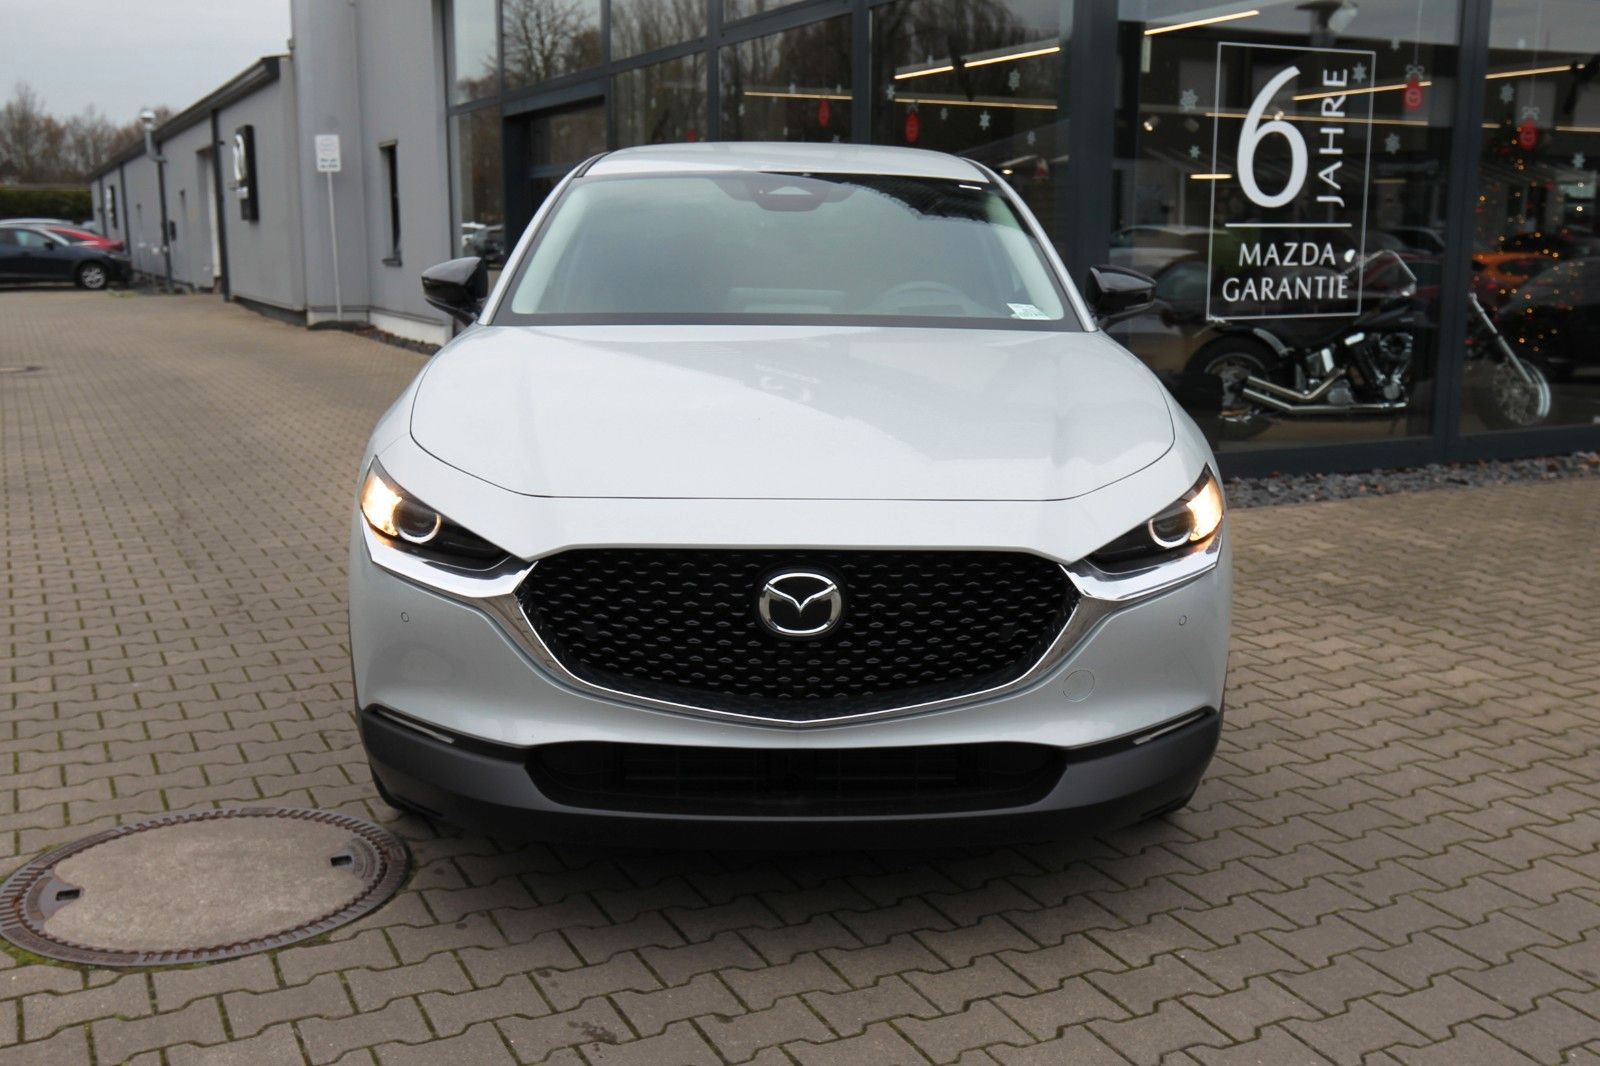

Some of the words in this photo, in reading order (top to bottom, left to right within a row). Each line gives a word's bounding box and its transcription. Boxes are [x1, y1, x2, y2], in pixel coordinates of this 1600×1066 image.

[1237, 65, 1308, 208] 6
[1316, 68, 1348, 207] JAHRE
[1222, 275, 1349, 302] GARANTIE
[1238, 242, 1336, 267] MAZDA
